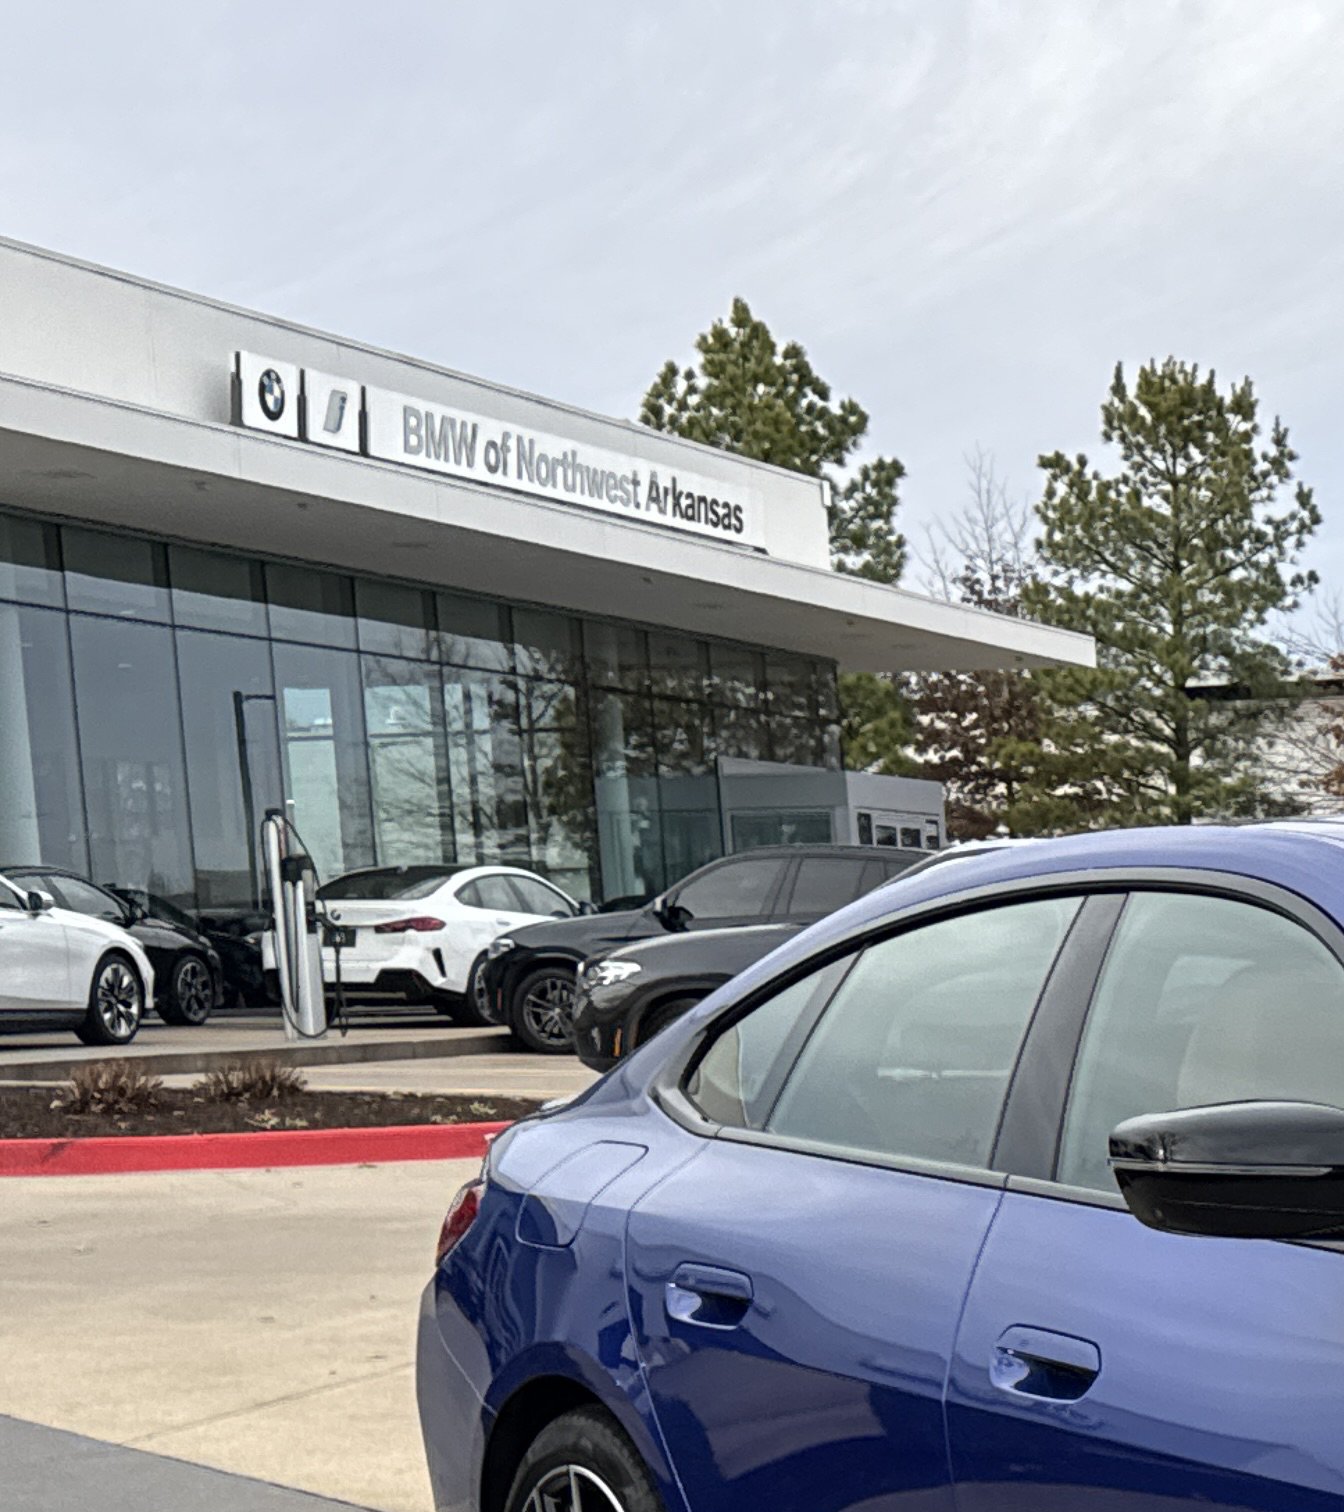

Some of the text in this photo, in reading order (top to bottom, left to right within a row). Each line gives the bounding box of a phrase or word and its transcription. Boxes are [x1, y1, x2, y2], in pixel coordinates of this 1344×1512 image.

[402, 405, 745, 535] BMW of Northwest Arkansas
